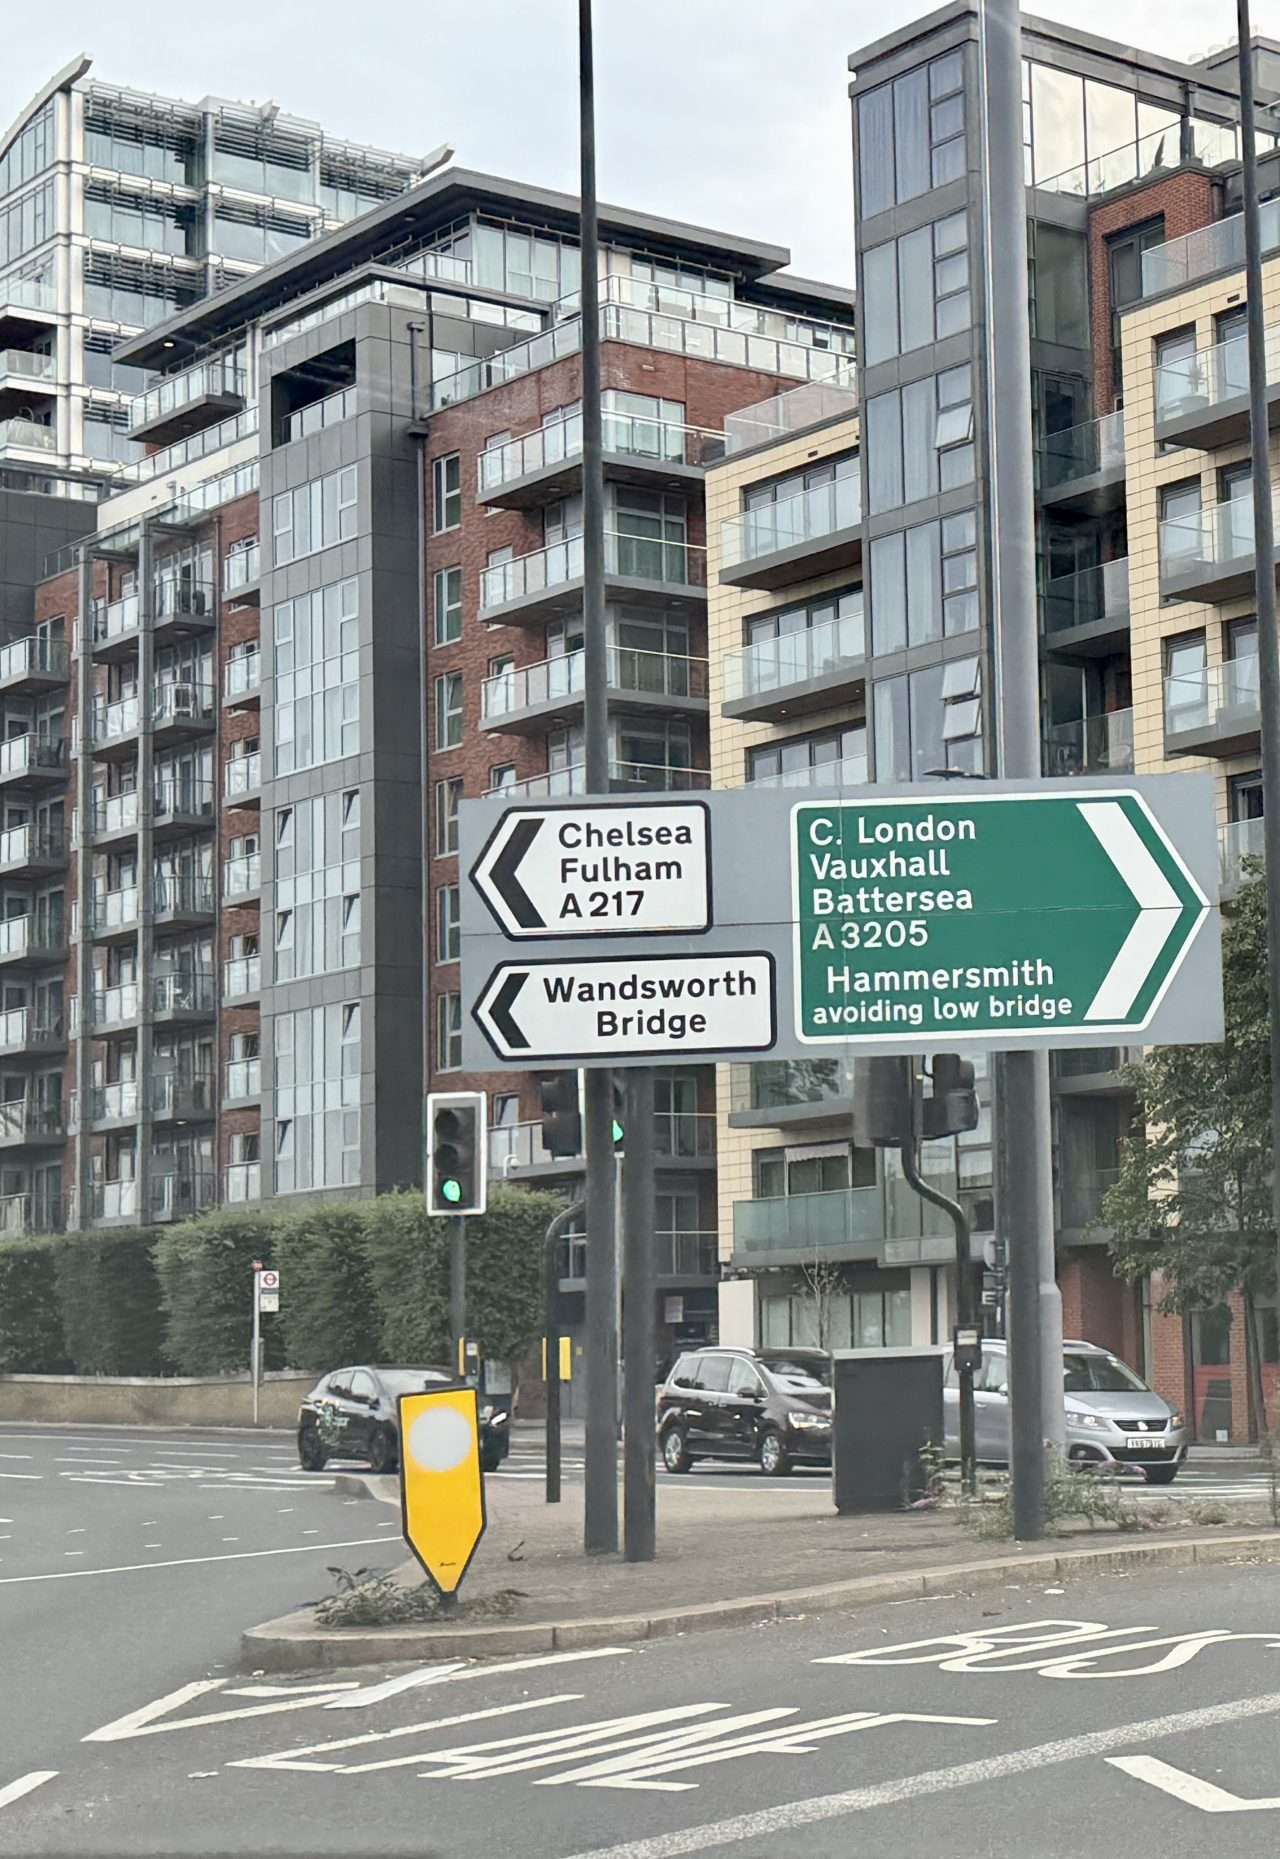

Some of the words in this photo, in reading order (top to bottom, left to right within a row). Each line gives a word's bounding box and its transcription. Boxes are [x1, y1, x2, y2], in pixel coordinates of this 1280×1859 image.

[557, 820, 693, 849] Chelsea
[809, 817, 843, 847] C.
[857, 813, 977, 845] London
[559, 856, 683, 884] Fulham
[809, 848, 951, 881] Vauxhall
[811, 886, 974, 916] Battersea
[542, 969, 757, 1003] Wandsworth
[825, 957, 1055, 994] Hammersmith
[596, 1008, 708, 1040] Bridge
[811, 994, 924, 1026] avoiding
[932, 994, 981, 1021] low
[988, 992, 1074, 1021] bridge
